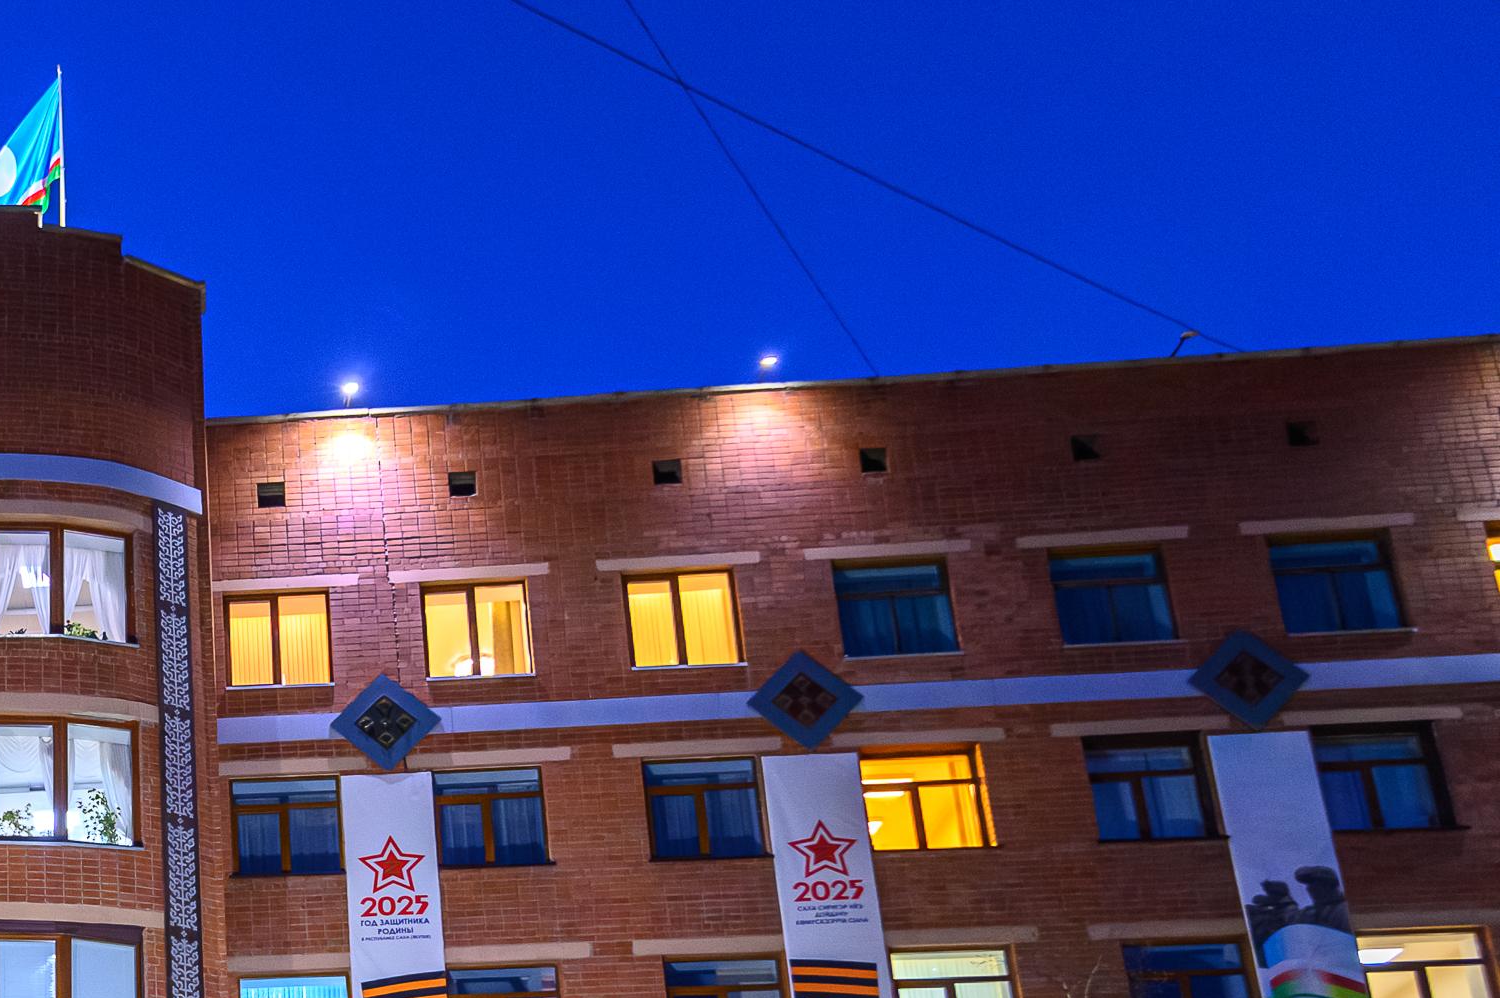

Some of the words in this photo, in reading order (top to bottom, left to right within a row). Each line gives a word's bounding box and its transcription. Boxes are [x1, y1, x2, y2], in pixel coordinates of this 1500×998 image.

[792, 879, 864, 902] 2025
[360, 895, 429, 917] 2025
[379, 918, 430, 926] ЗАЩИТНИКА
[377, 927, 414, 935] РОДИНЫ
